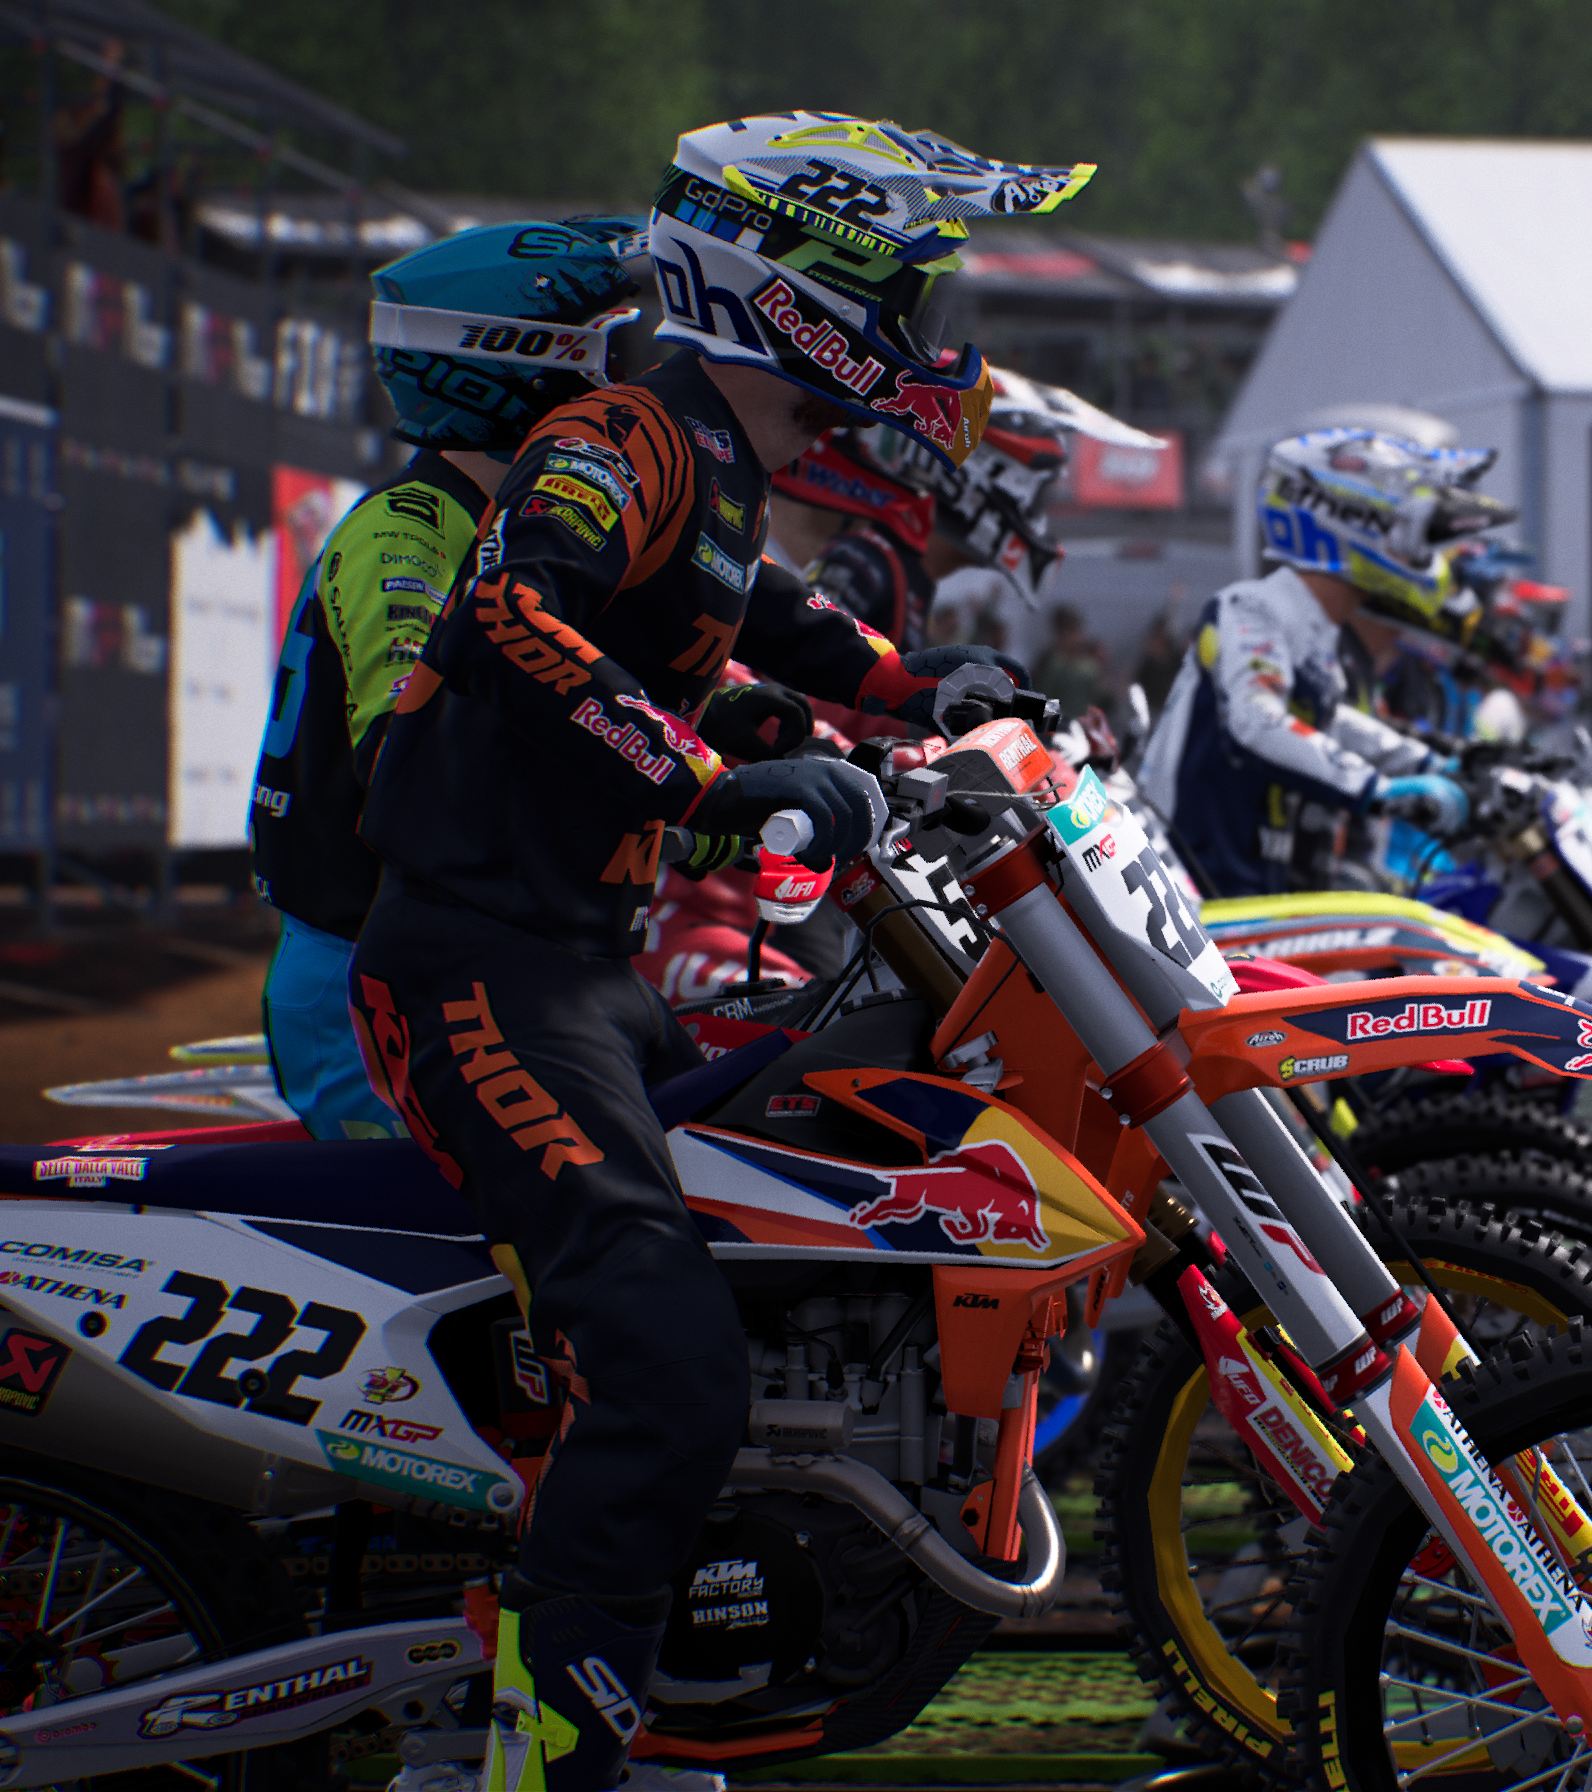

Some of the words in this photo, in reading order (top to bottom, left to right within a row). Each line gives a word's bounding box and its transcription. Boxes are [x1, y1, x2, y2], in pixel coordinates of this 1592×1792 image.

[684, 178, 774, 232] GoPro
[776, 158, 890, 231] 222
[457, 322, 588, 362] 100%
[475, 571, 595, 697] THOR
[783, 880, 818, 899] UFO
[441, 981, 607, 1182] THOR
[1278, 1054, 1350, 1082] SCRUB
[0, 1240, 148, 1273] COMISA
[11, 1275, 130, 1310] ATHENA
[953, 1292, 999, 1310] KTM
[117, 1271, 368, 1426] 222
[1226, 1373, 1262, 1406] UFO
[338, 1409, 446, 1443] MXGP
[360, 1446, 477, 1494] MOTOREX
[1448, 1468, 1562, 1628] MOTOREX
[1516, 1519, 1584, 1613] ATHENA
[688, 1575, 766, 1600] FACTORY
[692, 1558, 759, 1586] KTM
[691, 1599, 769, 1625] HINSON
[1160, 1637, 1274, 1760] PIRELLI
